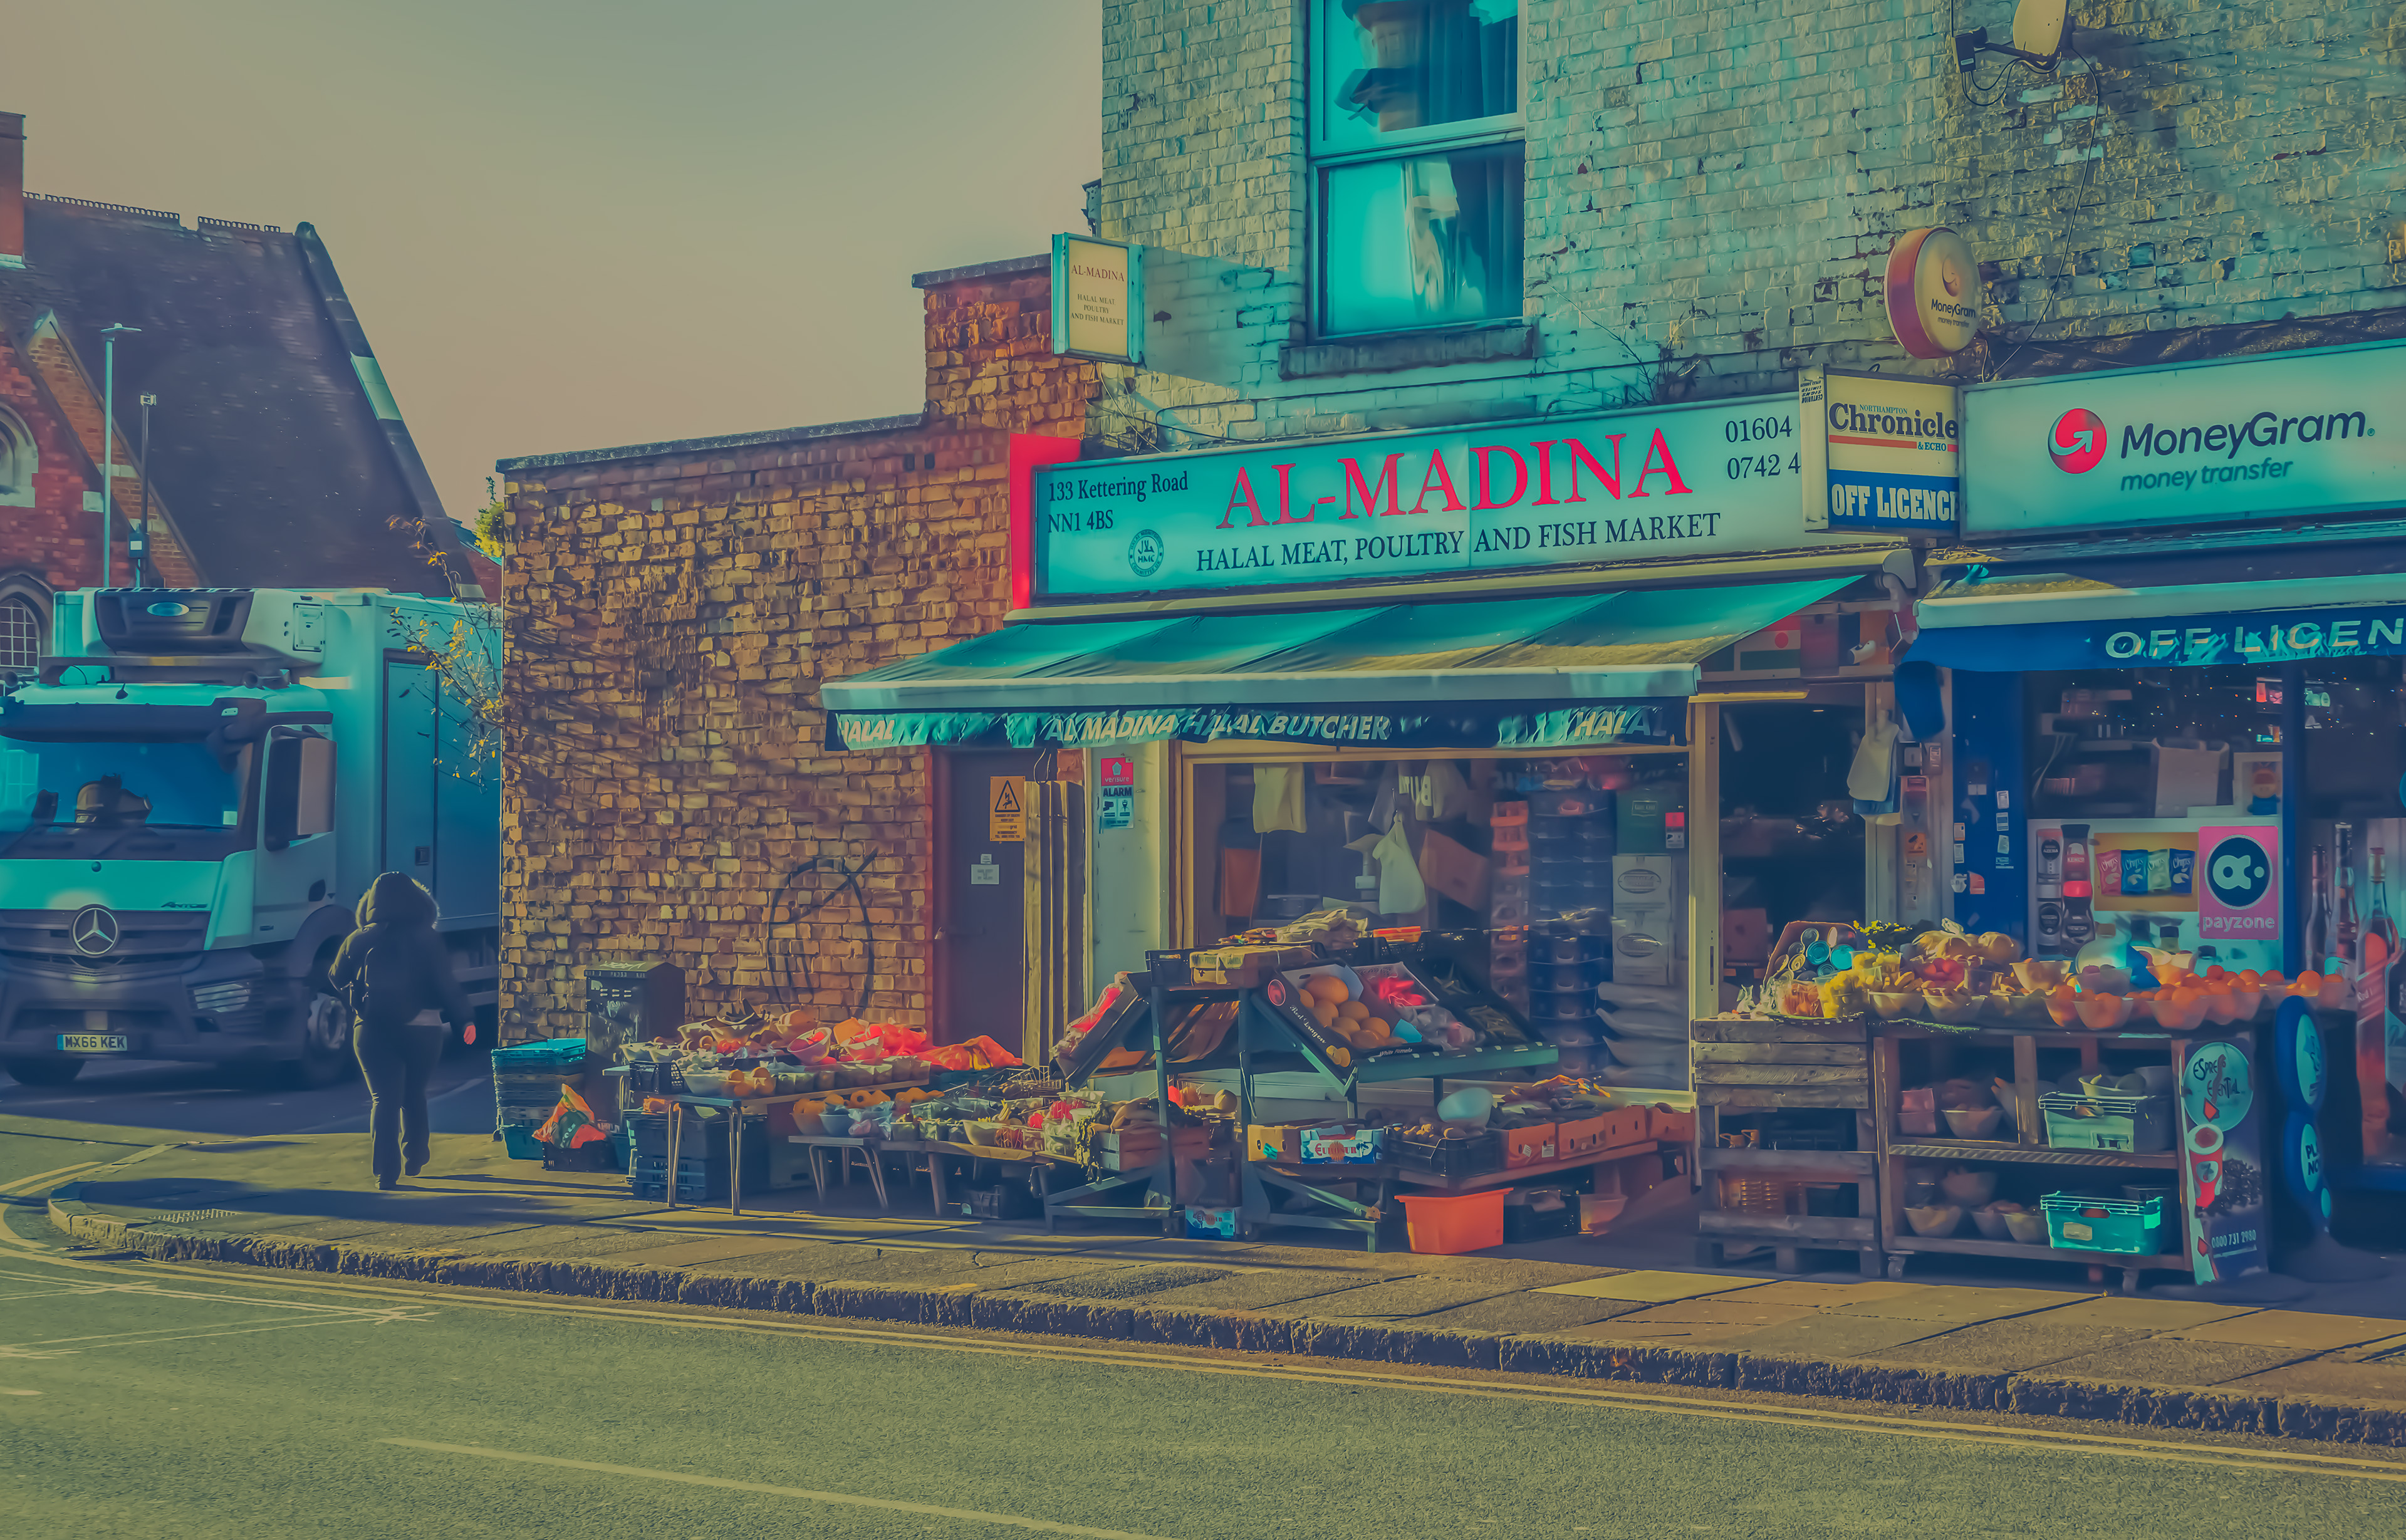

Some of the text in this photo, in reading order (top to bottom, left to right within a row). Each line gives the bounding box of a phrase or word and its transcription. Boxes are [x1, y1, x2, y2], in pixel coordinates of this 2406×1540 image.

[1071, 264, 1124, 281] AL-MADINA
[1078, 294, 1097, 303] HALAL
[1084, 304, 1109, 313] POULTRY
[1931, 298, 1976, 318] MoneyGram
[1085, 314, 1098, 322] FISH
[1100, 316, 1124, 325] MARKET
[1937, 317, 1952, 326] money
[1801, 393, 1823, 404] CENTURION
[1860, 404, 1908, 414] NORTHAMPTON
[1725, 415, 1793, 443] 01604
[1829, 402, 1959, 440] Chronicle
[2120, 410, 2366, 459] MoneyGram
[1918, 442, 1947, 452] & ECHO
[1727, 452, 1801, 479] 0742 4
[1216, 427, 1693, 529] AL-MADINA
[2120, 457, 2293, 492] money transfer
[1049, 471, 1189, 502] 133 Kettering Road
[1831, 484, 1871, 517] OFF
[1048, 509, 1114, 533] NN1 4BS
[1196, 512, 1721, 572] HALAL MEAT, POULTRY AND FISH MARKET
[1138, 554, 1155, 563] HMC
[2105, 627, 2212, 658] OFF
[1080, 714, 1179, 741] MADINA
[1267, 715, 1391, 740] BUTCHER
[1573, 710, 1667, 737] HALAL
[1103, 786, 1132, 797] ALARM
[2101, 856, 2118, 871] Chips
[2125, 856, 2143, 870] Chips
[2172, 856, 2191, 869] Chips
[2202, 917, 2275, 932] payzone
[65, 1036, 125, 1049] MX66 KEK
[2211, 1235, 2227, 1249] 0800
[2229, 1232, 2239, 1245] 731
